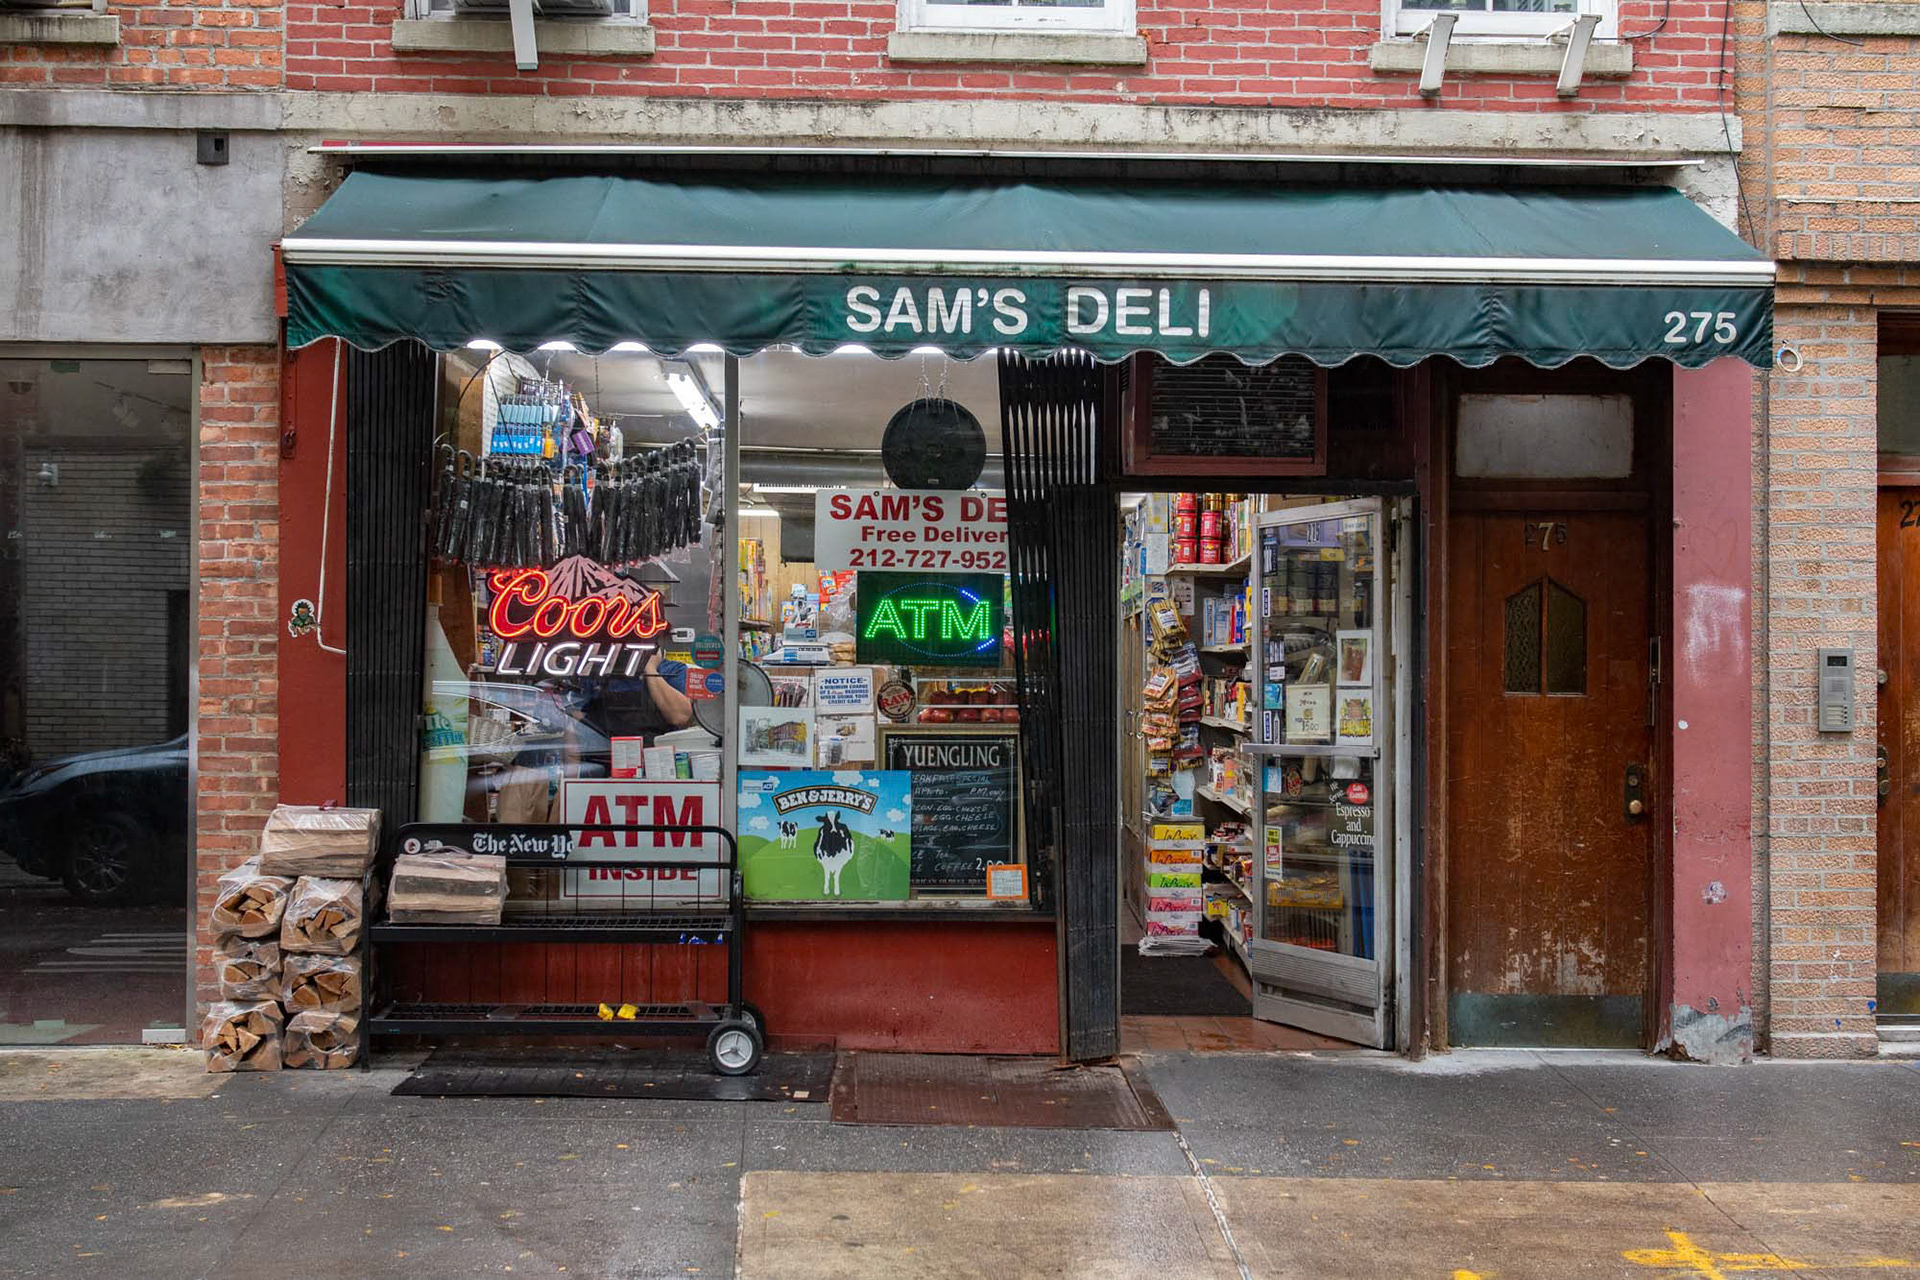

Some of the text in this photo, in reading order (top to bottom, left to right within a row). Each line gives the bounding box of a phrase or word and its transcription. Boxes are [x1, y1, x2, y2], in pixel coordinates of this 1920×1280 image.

[846, 286, 1210, 338] SAM'S DELI
[1664, 311, 1737, 344] 275
[830, 494, 944, 522] SAM'S
[861, 526, 916, 543] Free
[488, 570, 667, 638] Coors
[864, 599, 990, 640] ATM
[496, 641, 659, 677] LIGHT
[881, 691, 912, 707] RAW
[903, 745, 1000, 767] YUENGLING
[778, 790, 809, 810] BEN
[819, 789, 873, 810] JERRY'S
[1336, 802, 1370, 820] Espresso
[578, 795, 703, 848] ATM
[1346, 818, 1361, 832] and
[473, 832, 506, 854] The
[509, 833, 548, 854] New
